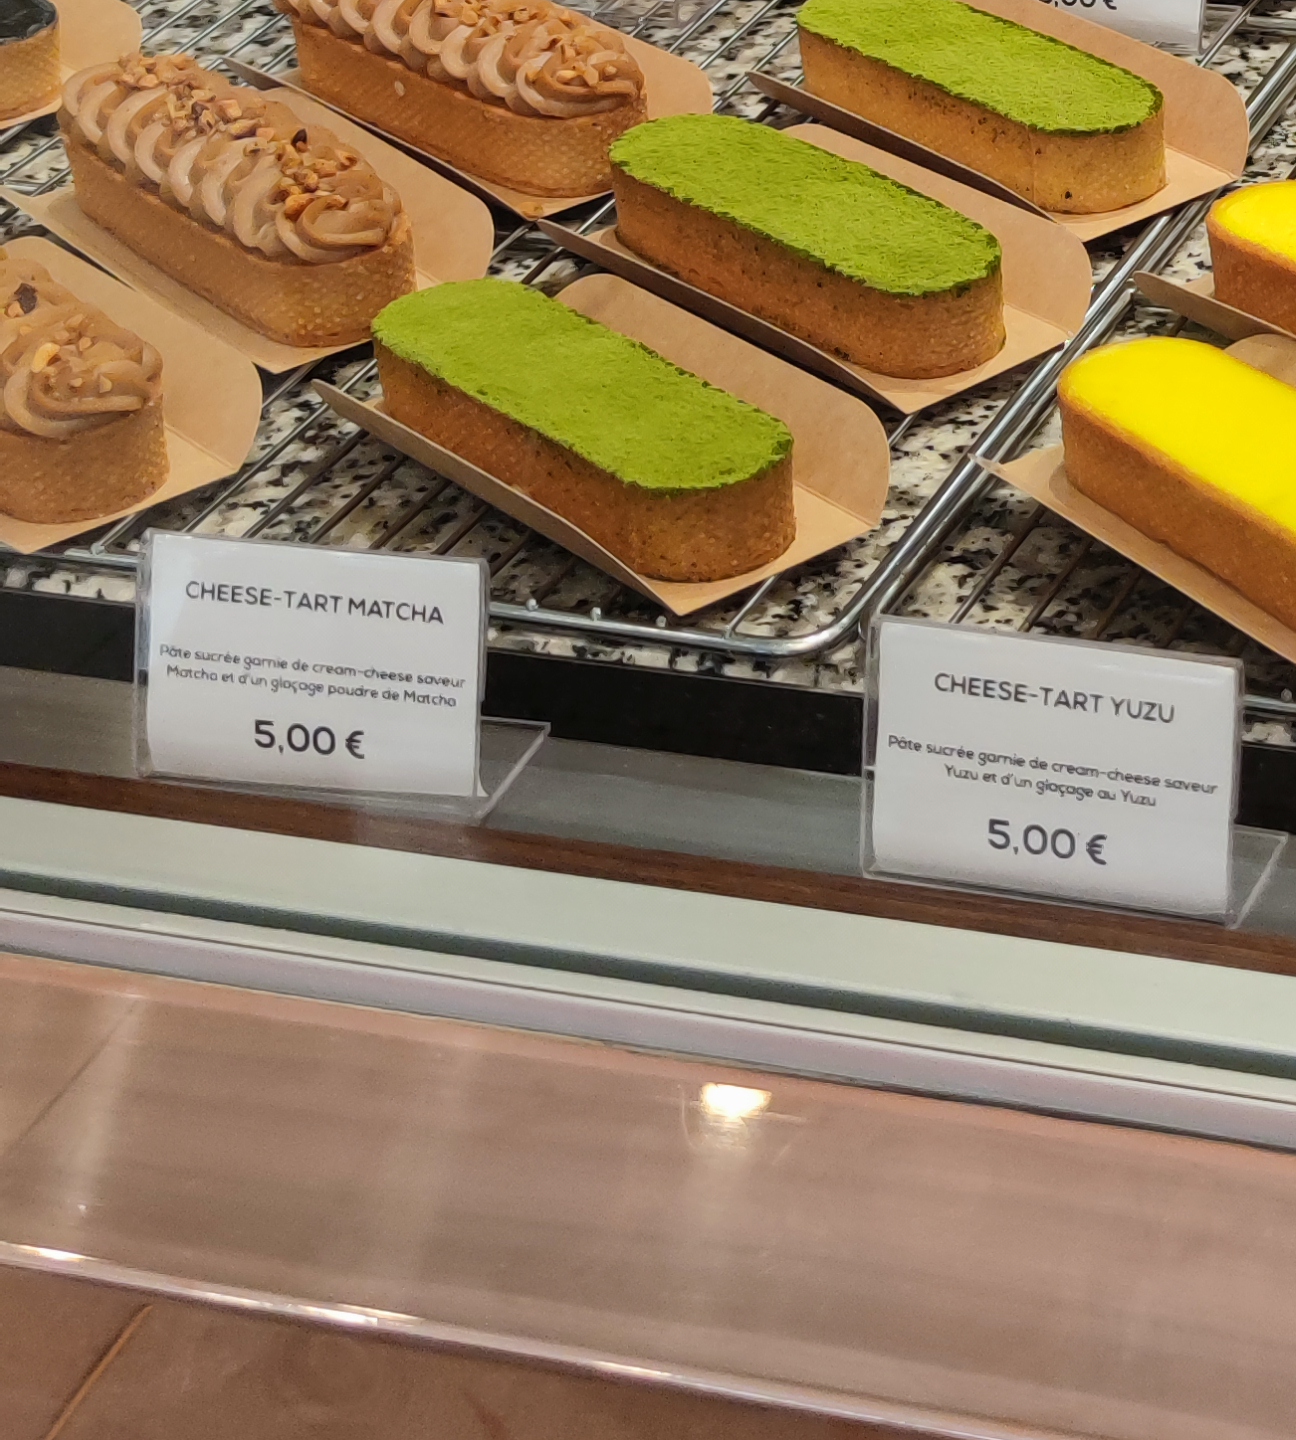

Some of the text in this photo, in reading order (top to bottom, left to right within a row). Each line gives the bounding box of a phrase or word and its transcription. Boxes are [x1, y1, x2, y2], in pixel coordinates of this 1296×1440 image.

[186, 581, 443, 624] CHEESE-TART MATCHA
[160, 645, 465, 687] Pâte sucrée garnie de cream-cheese saveur
[167, 665, 456, 707] Matcha et d'un glaçage poudre de Matcha
[935, 673, 1174, 723] CHEESE-TART YUZU
[255, 720, 364, 759] 5,00 €
[889, 735, 1218, 794] Pâte sucrée garnie de cream-cheese saveur
[944, 764, 1156, 806] Yuzu et d'un glaçage au Yuzu
[988, 819, 1107, 865] 5,00 €
